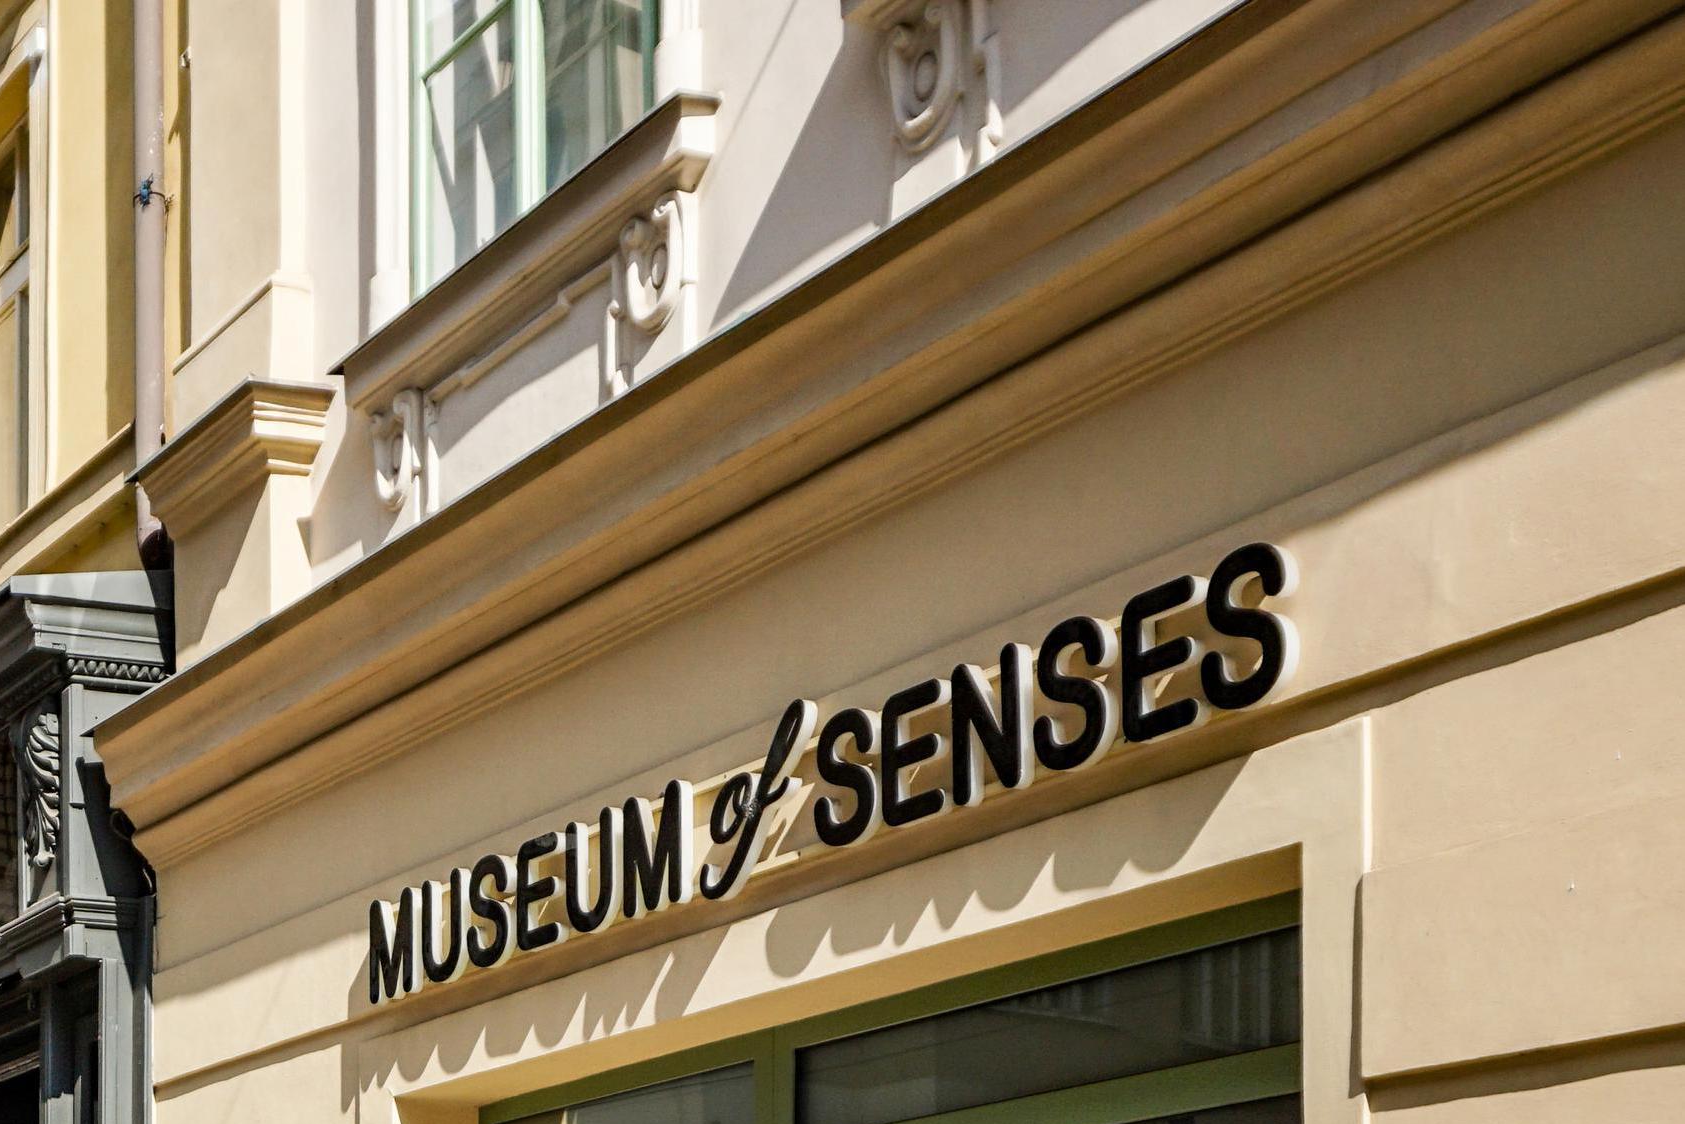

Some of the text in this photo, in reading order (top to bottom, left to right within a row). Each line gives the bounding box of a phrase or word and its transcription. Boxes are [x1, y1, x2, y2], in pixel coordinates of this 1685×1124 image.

[368, 541, 1298, 1006] MUSEUM of SENSES
